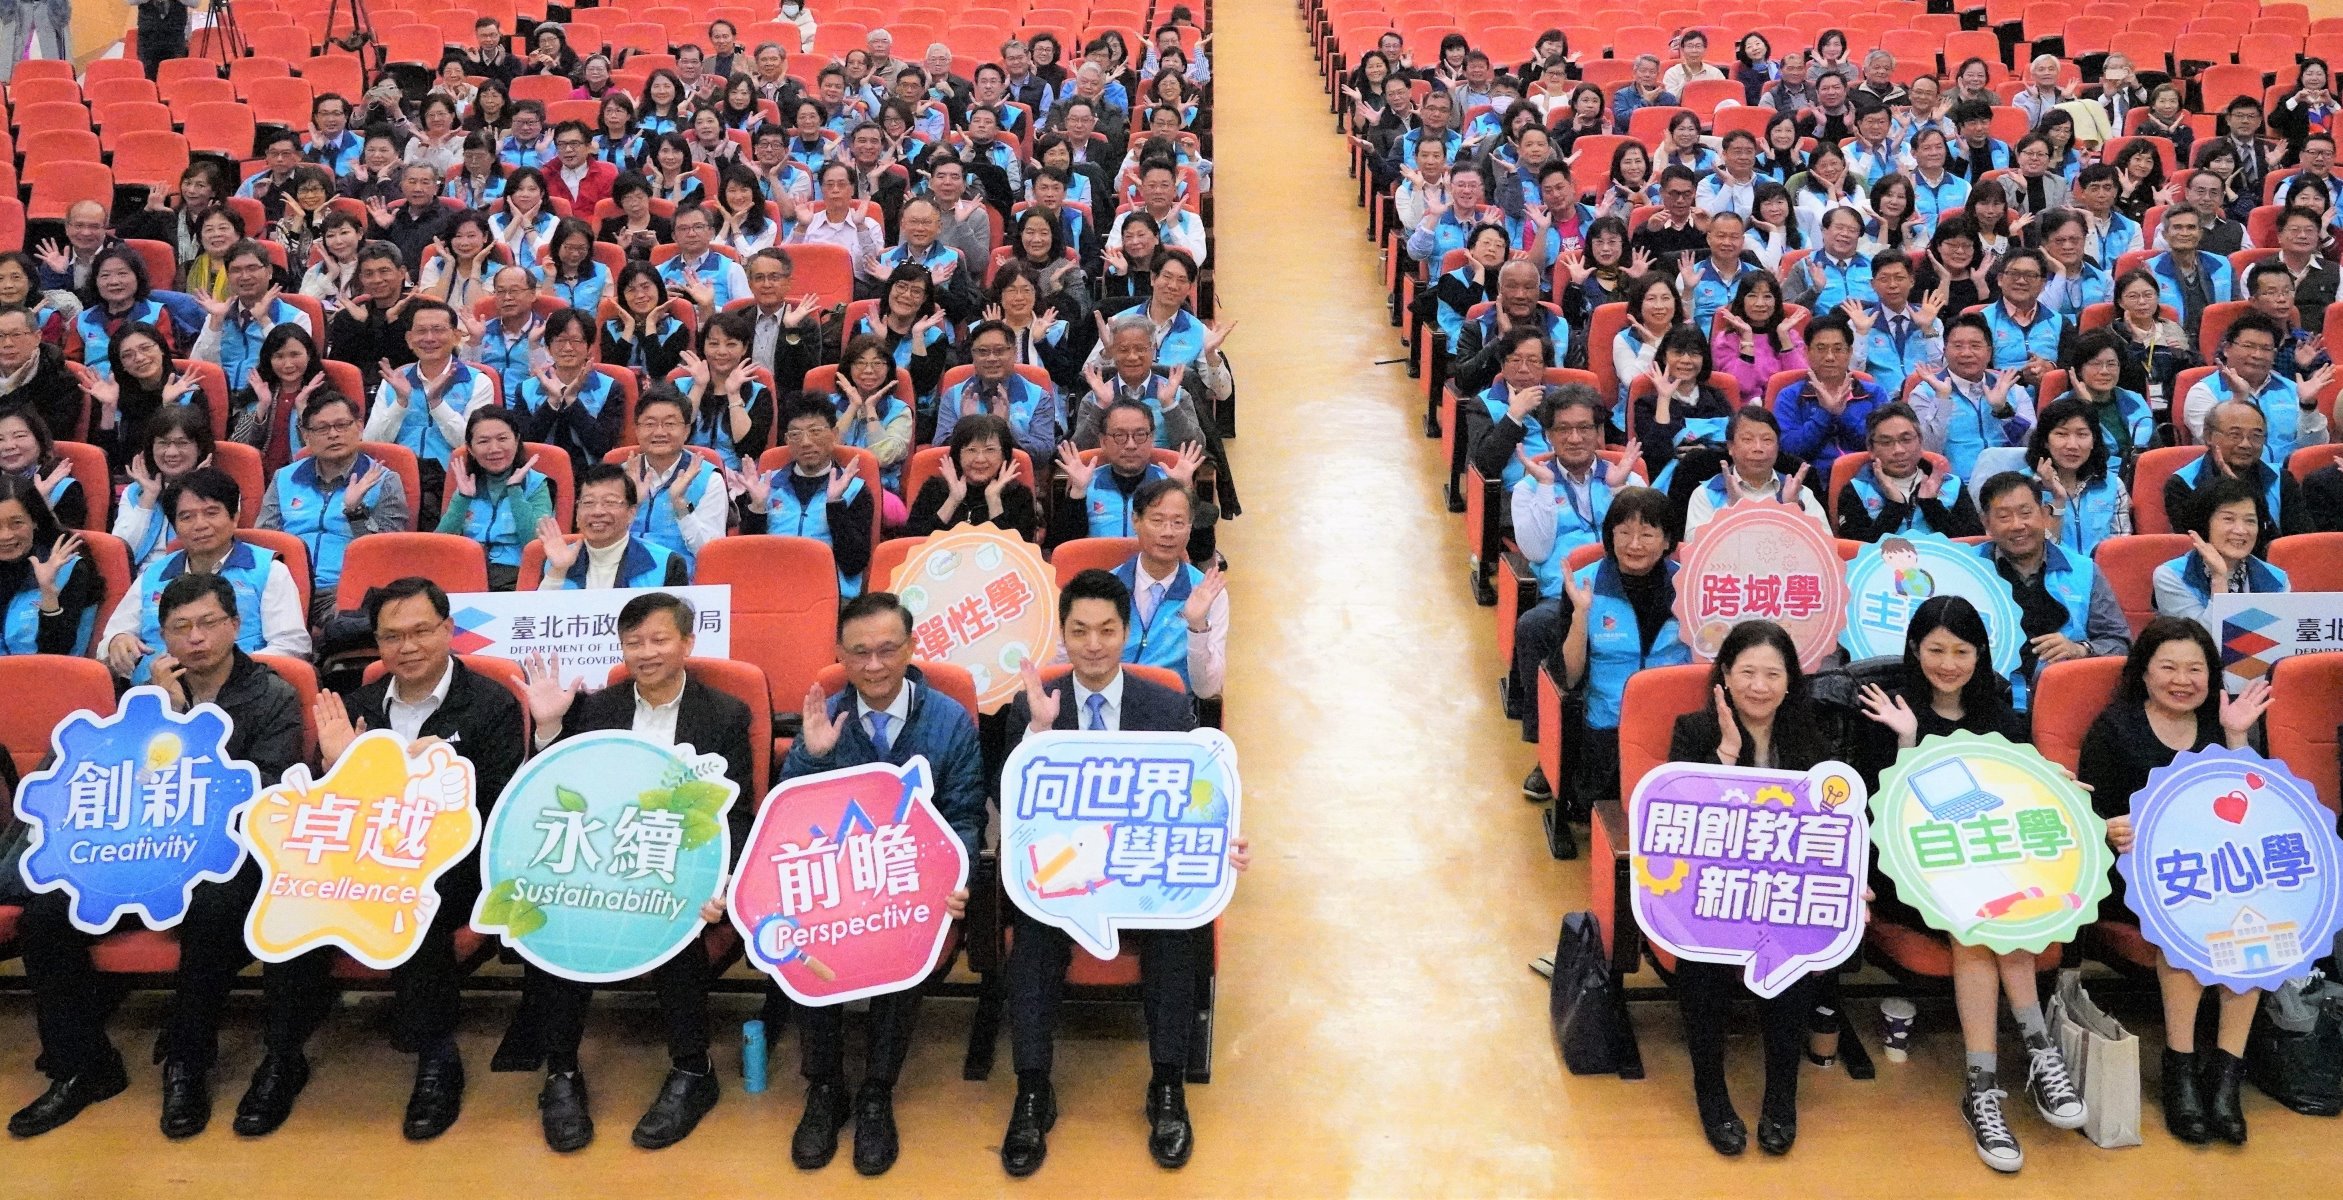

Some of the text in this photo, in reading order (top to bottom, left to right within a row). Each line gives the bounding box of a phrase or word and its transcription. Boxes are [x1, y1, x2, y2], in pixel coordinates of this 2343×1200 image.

[511, 610, 722, 640] 臺北市政局
[912, 570, 1033, 661] 彈性學
[1701, 574, 1823, 618] 跨域學
[547, 657, 575, 666] CTY
[62, 755, 212, 831] 創新
[1019, 758, 1192, 819] 向世界
[69, 831, 198, 864] Creativity
[283, 793, 438, 869] 卓越
[528, 806, 686, 884] 永續
[1107, 824, 1226, 885] 學習
[1642, 800, 1851, 868] 開創教育
[1909, 807, 2074, 870] 自主學
[270, 873, 417, 904] Excellence
[510, 876, 688, 921] Sustainability
[770, 821, 921, 917] 前瞻
[1695, 866, 1851, 929] 新格局
[2155, 831, 2316, 907] 安心學
[776, 903, 930, 950] Perspective
